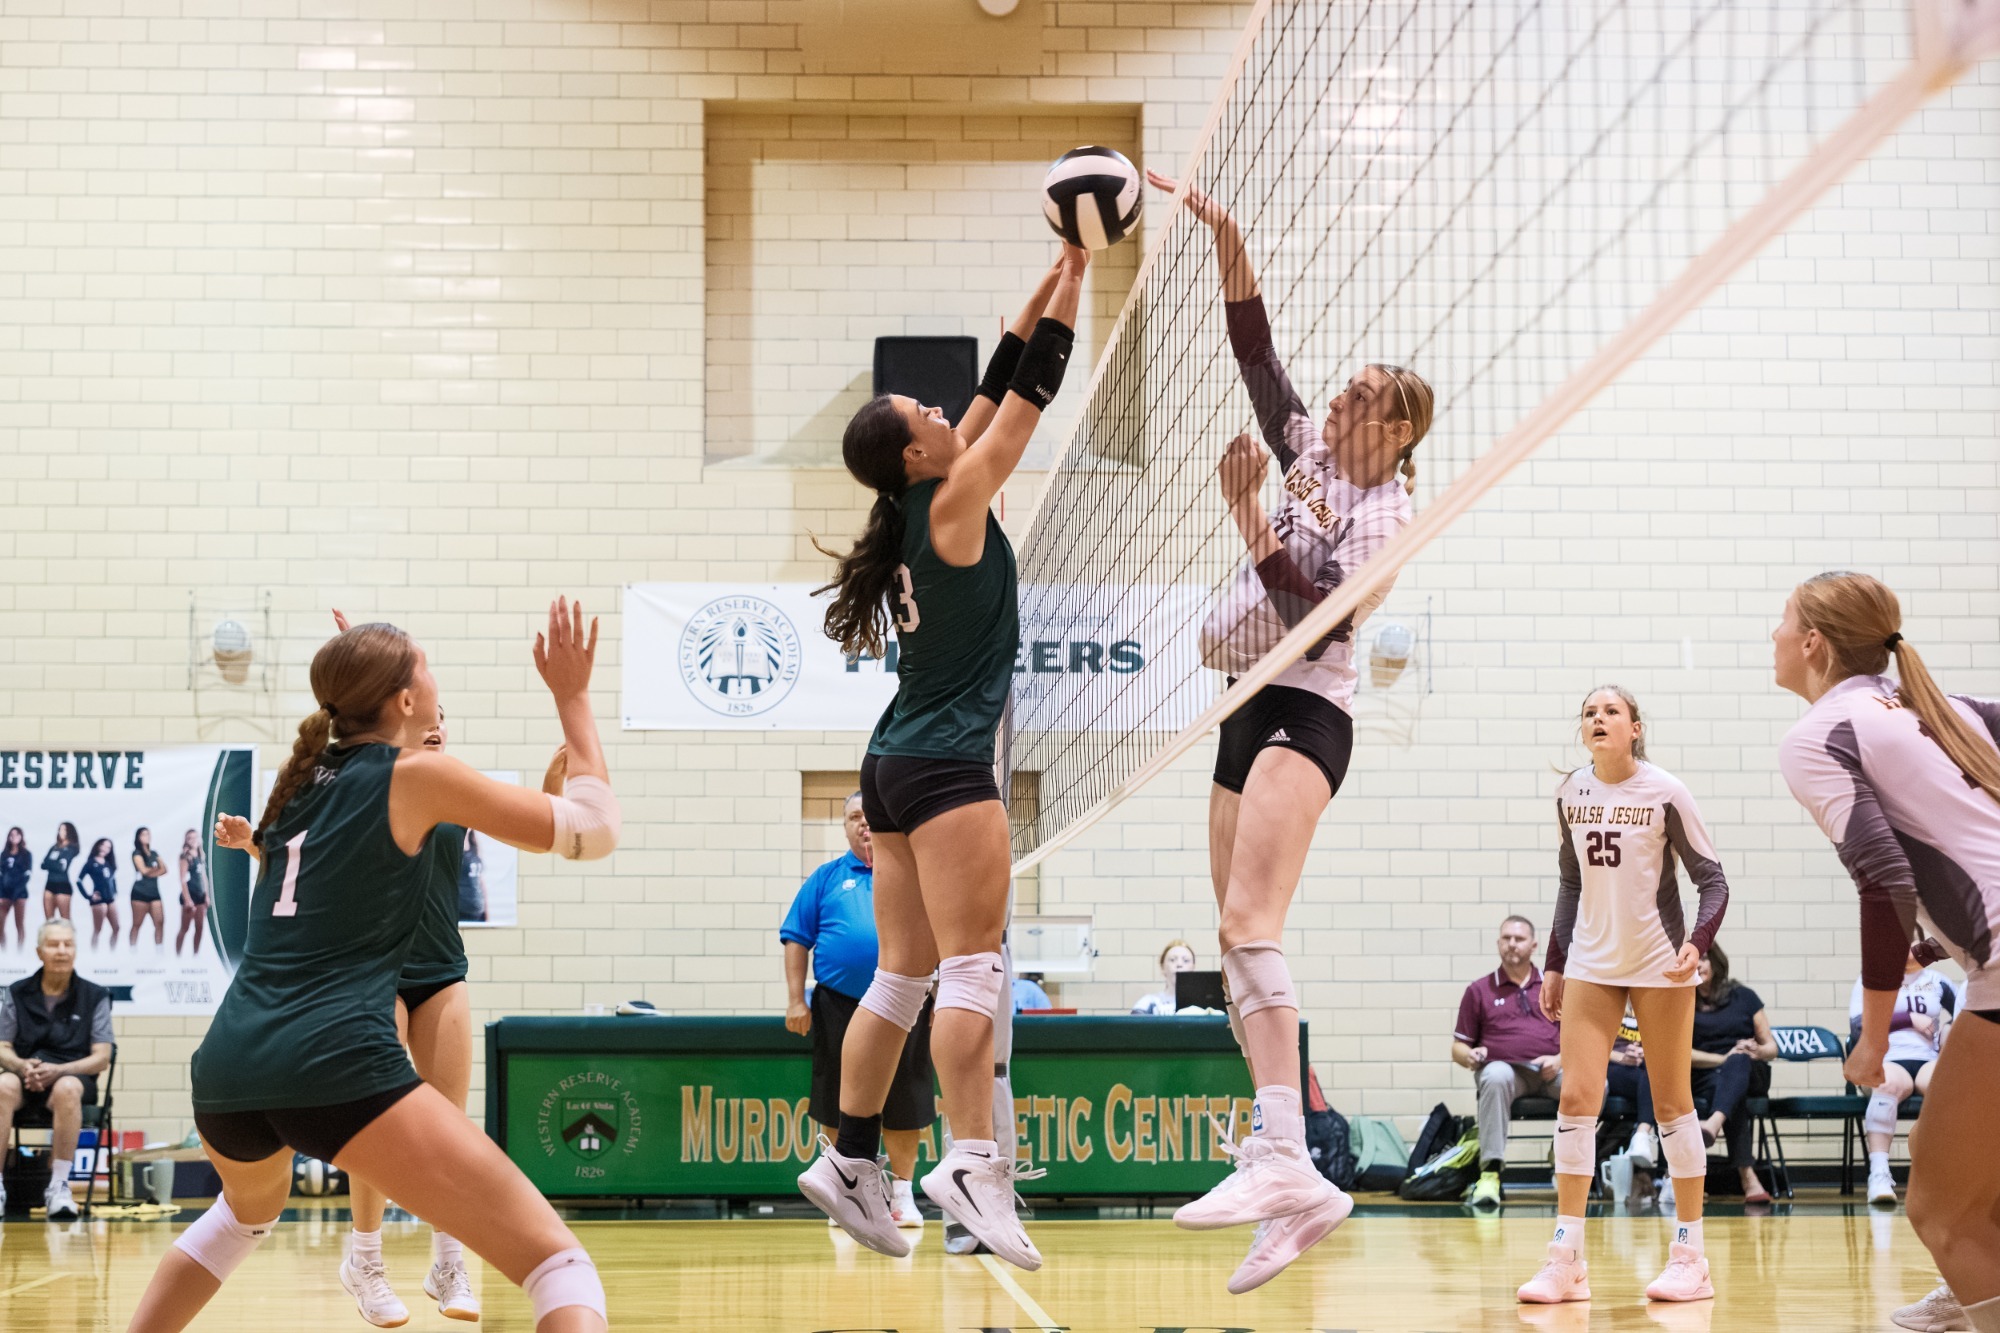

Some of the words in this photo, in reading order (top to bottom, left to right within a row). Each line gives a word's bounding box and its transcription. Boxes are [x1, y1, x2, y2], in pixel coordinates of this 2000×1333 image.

[892, 562, 921, 633] 3
[683, 619, 706, 684] WESTERN
[705, 600, 769, 618] RESERVE
[773, 615, 797, 684] ACADEMY
[727, 702, 754, 713] 1826
[0, 751, 144, 789] ESERVE
[1567, 805, 1605, 825] WALSH
[1608, 806, 1655, 826] JESUIT
[1586, 831, 1622, 868] 25
[272, 829, 309, 917] 1
[1906, 995, 1928, 1015] 16
[1771, 1028, 1828, 1054] WRA
[538, 1089, 560, 1157] WESTERN
[559, 1071, 622, 1091] RESERVE
[620, 1090, 642, 1156] ACADEMY
[680, 1085, 830, 1163] MURDO
[575, 1165, 605, 1178] 1826
